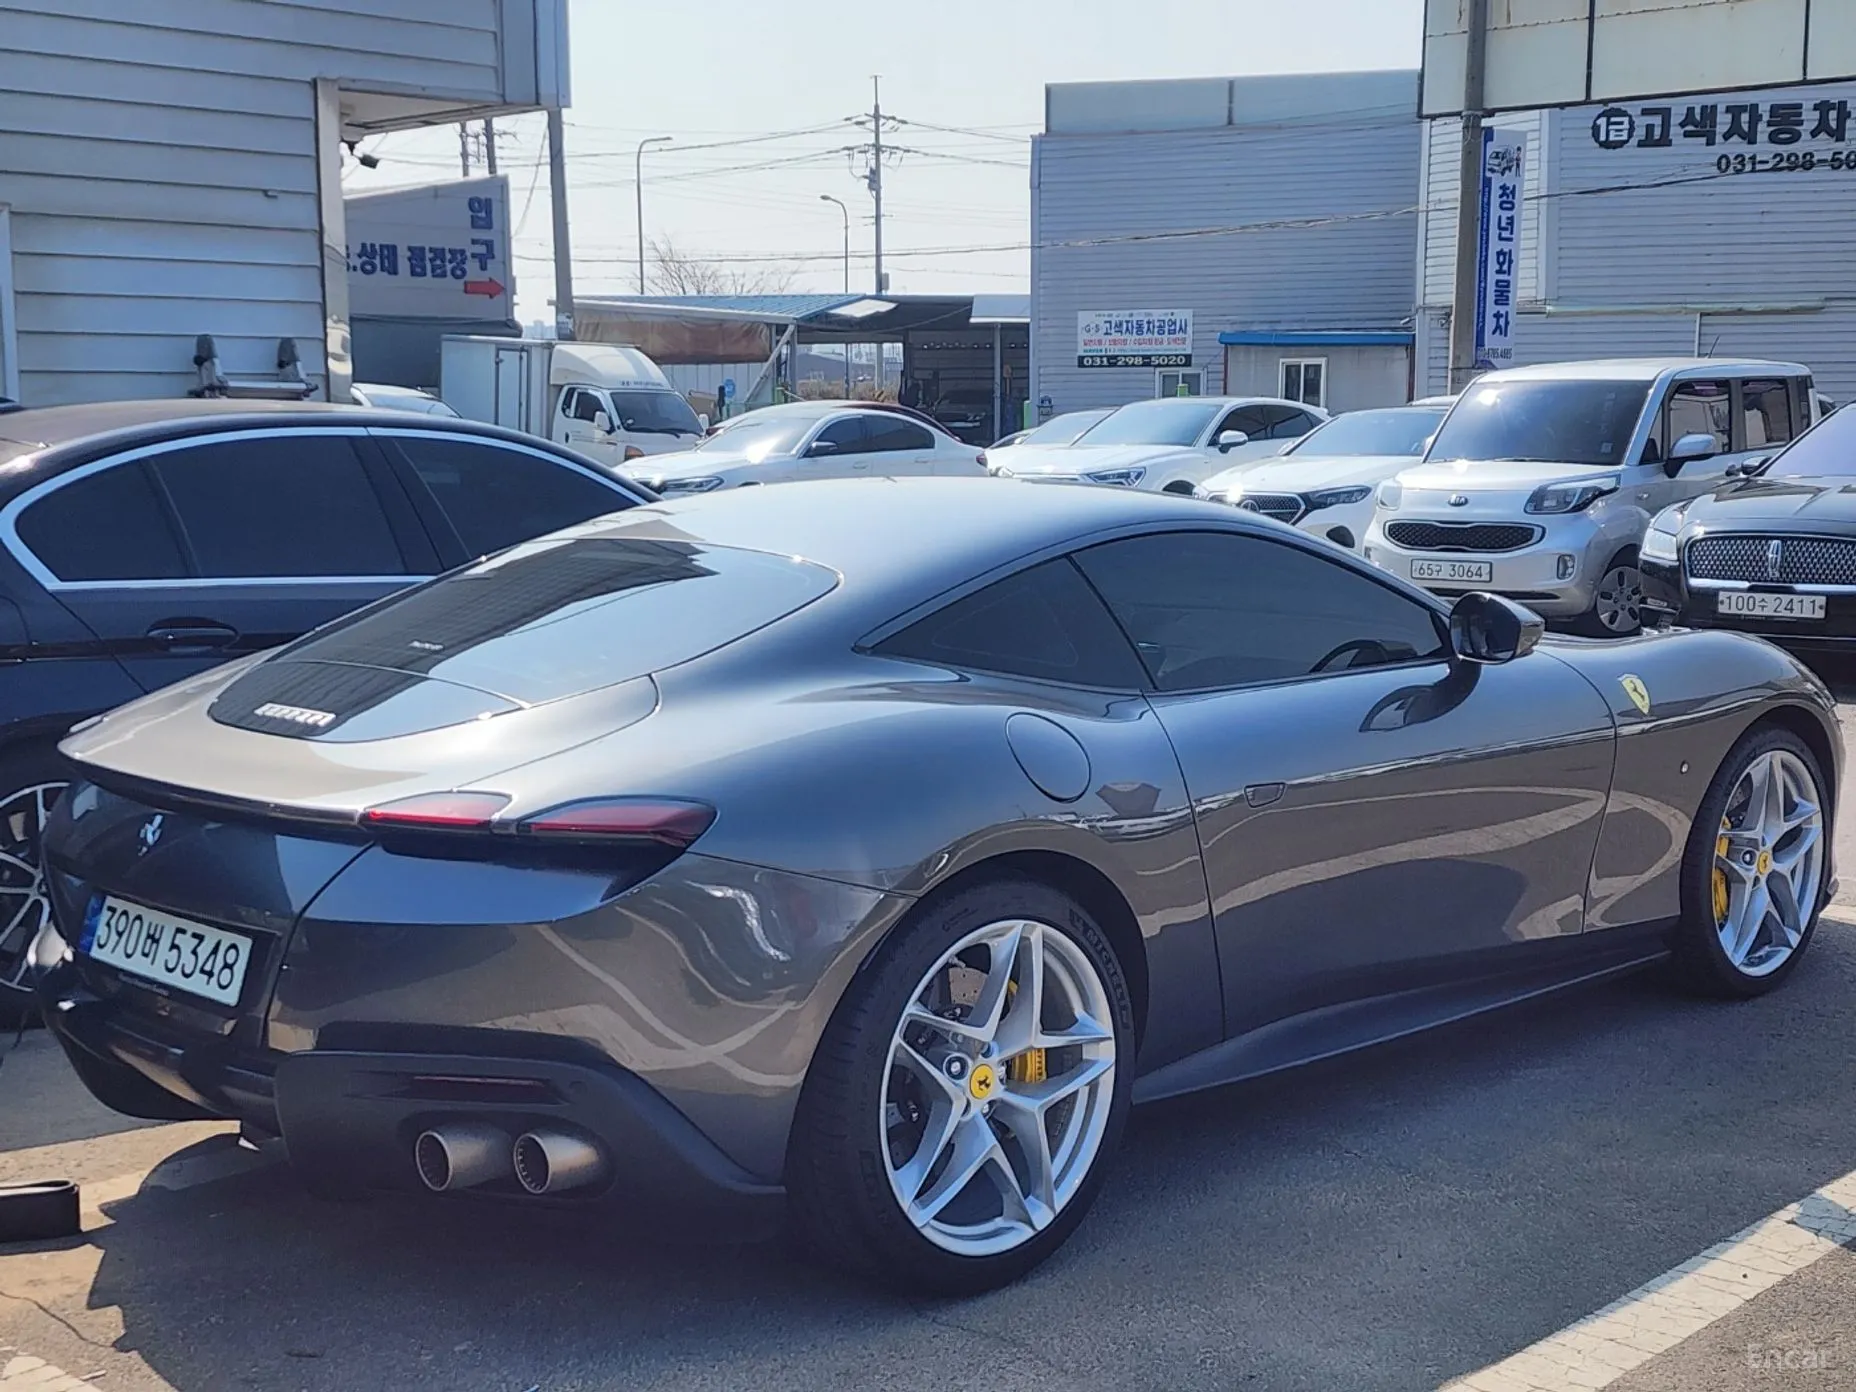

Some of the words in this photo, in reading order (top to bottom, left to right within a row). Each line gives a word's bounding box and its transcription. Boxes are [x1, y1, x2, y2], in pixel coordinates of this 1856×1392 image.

[345, 242, 399, 276] .상태
[1103, 318, 1188, 336] 고색자동차공업사
[1083, 355, 1186, 366] 031-298-5020
[1448, 564, 1484, 579] 3064
